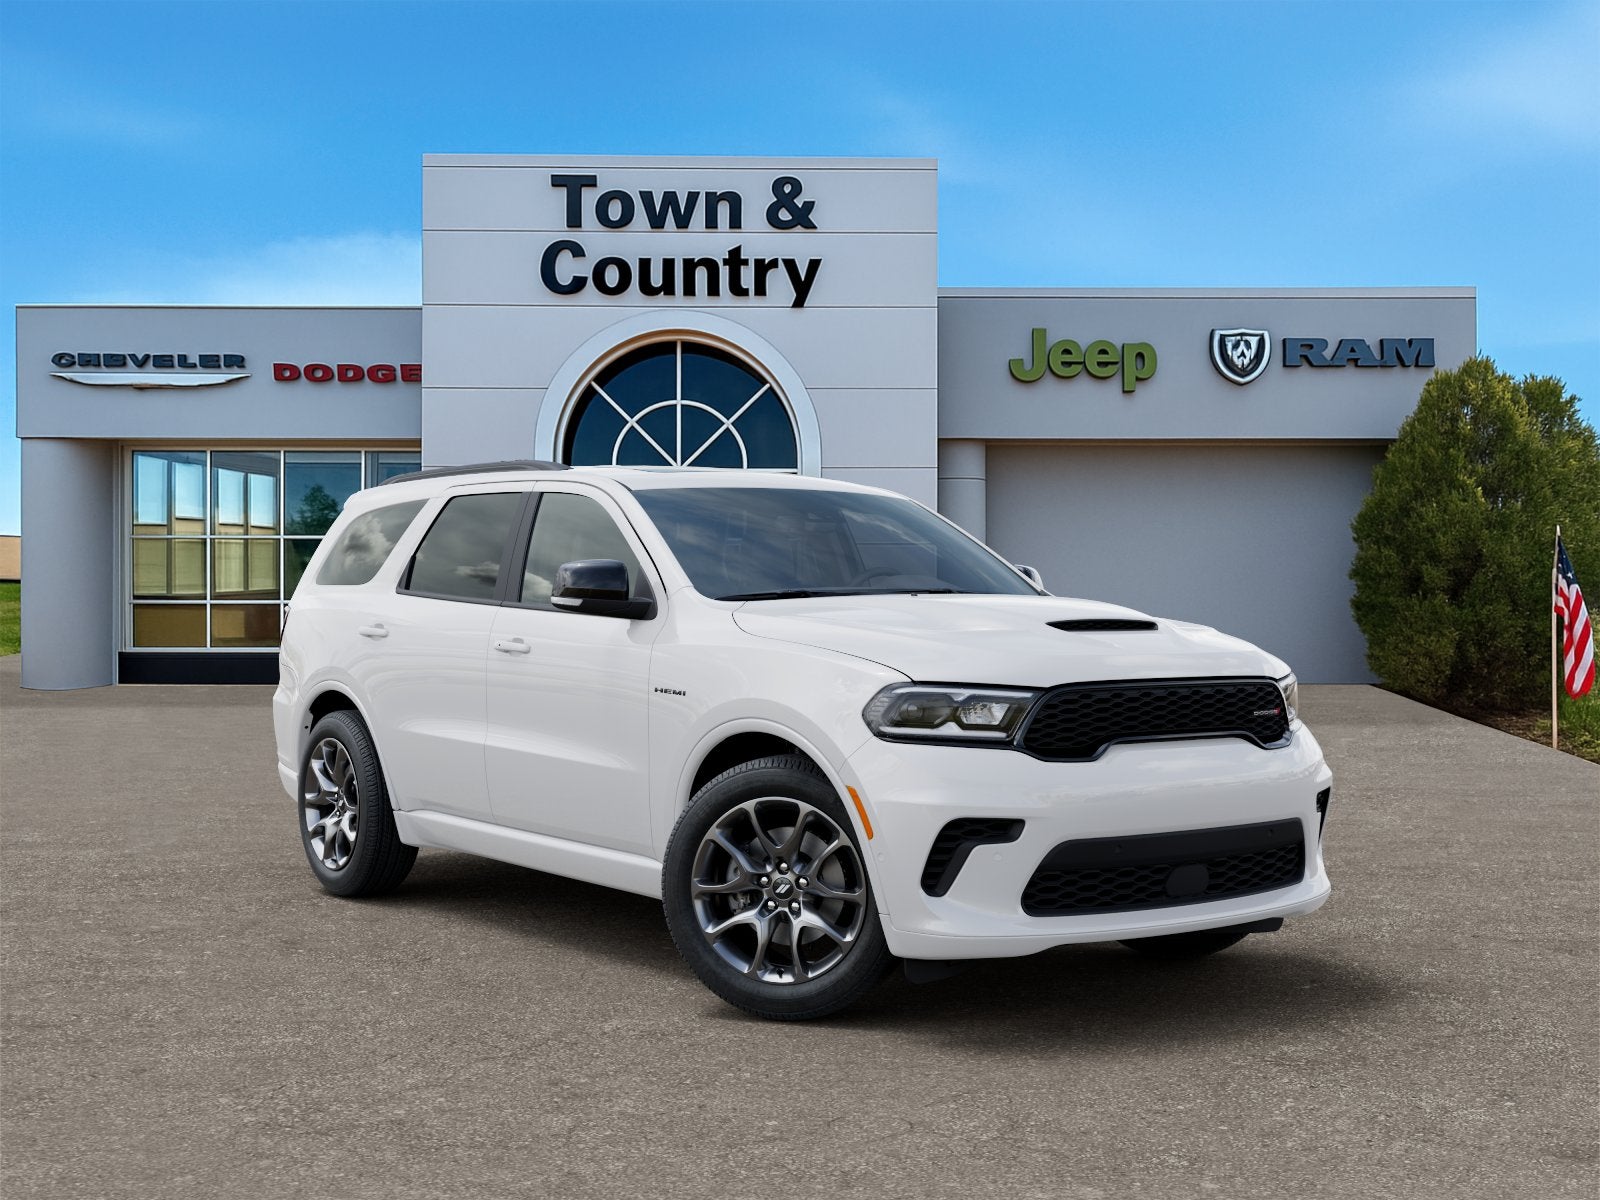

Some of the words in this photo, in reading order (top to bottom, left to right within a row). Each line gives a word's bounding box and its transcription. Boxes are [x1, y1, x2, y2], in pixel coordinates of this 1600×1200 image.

[550, 174, 742, 230] Town
[765, 175, 818, 230] &
[540, 239, 822, 308] Country
[272, 362, 422, 384] DODGE
[1008, 327, 1158, 393] Jeep
[1282, 337, 1435, 368] RAM
[654, 687, 687, 697] HEMI
